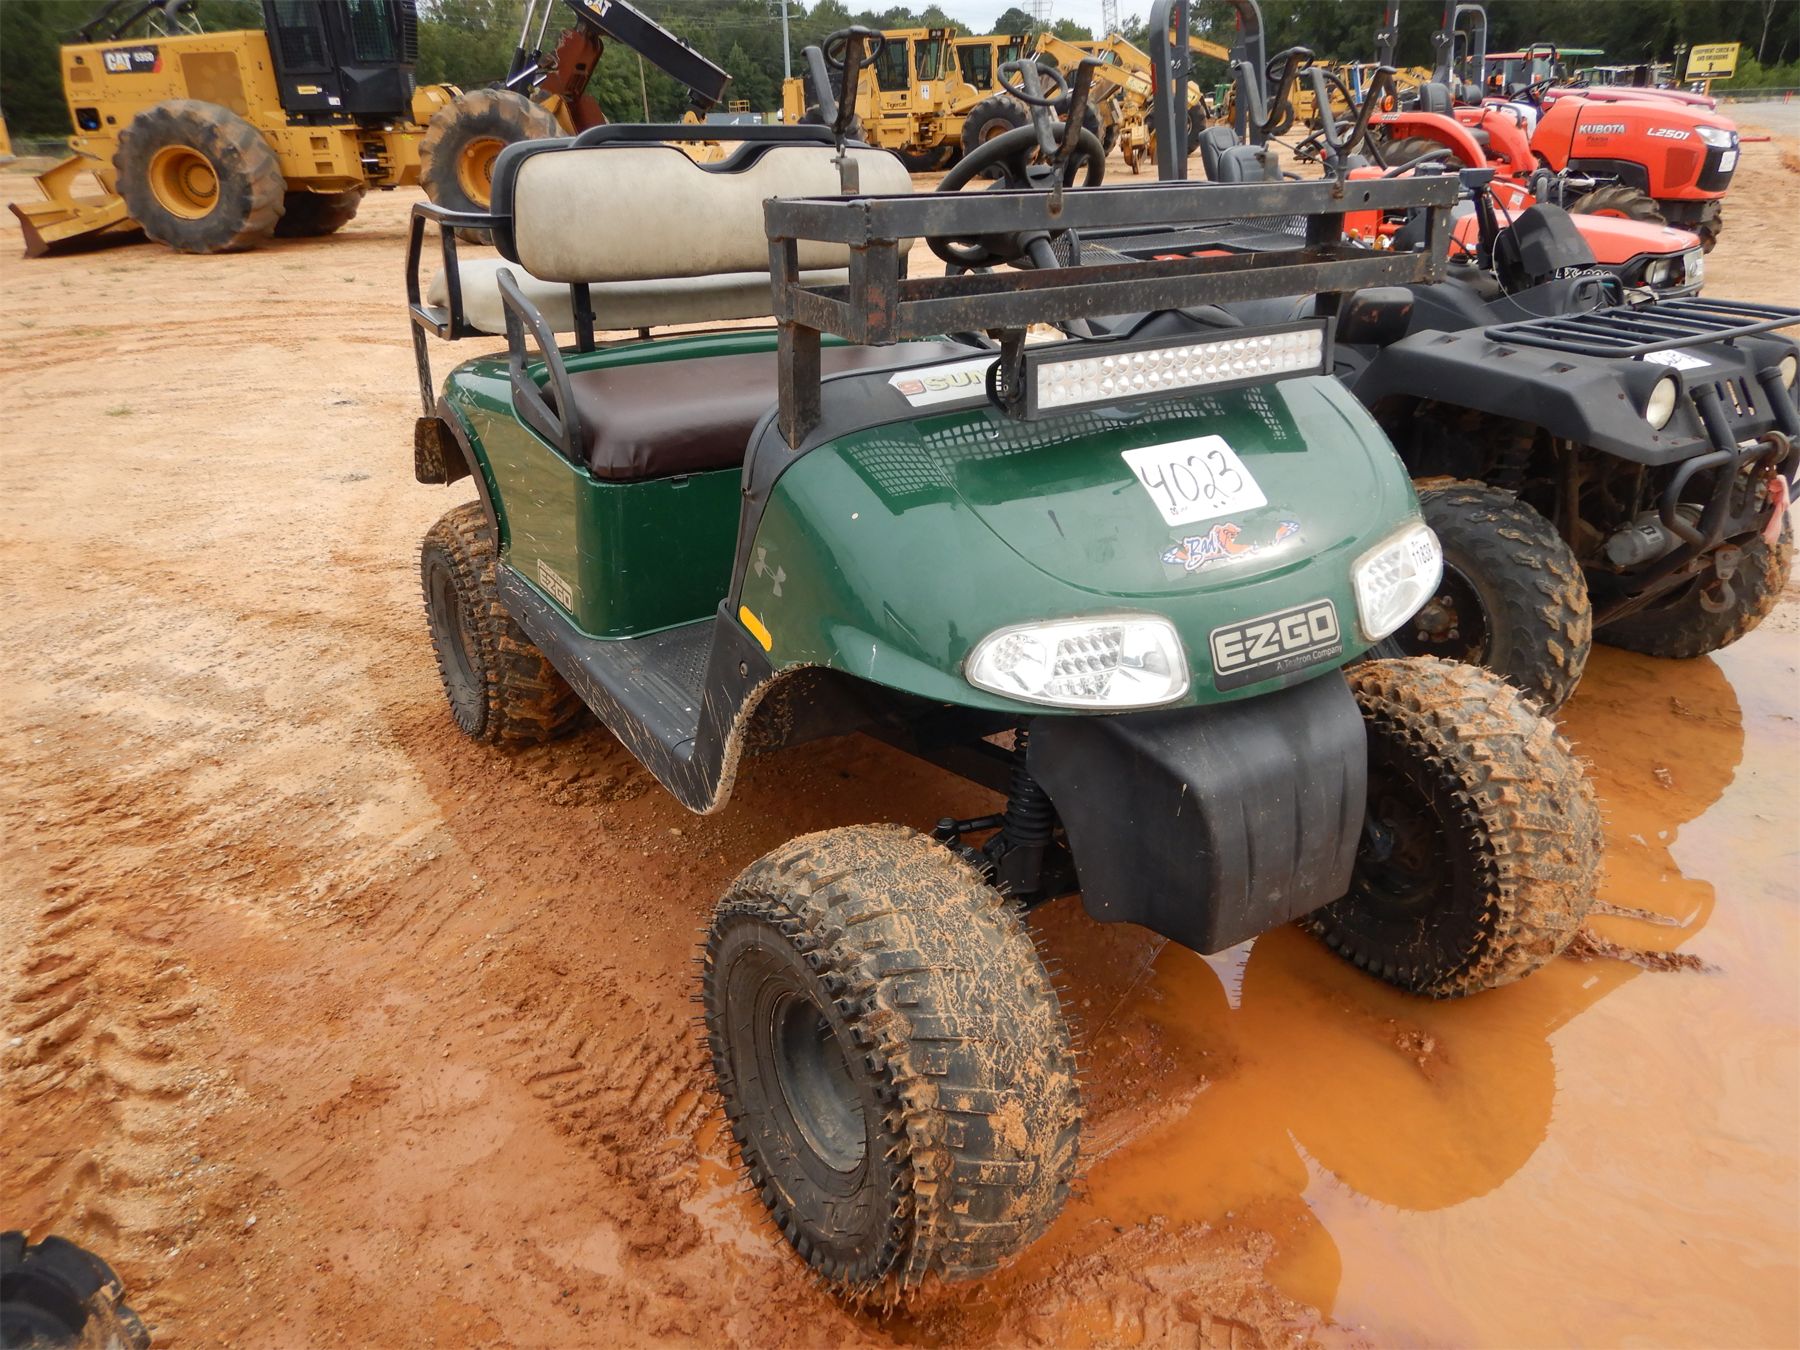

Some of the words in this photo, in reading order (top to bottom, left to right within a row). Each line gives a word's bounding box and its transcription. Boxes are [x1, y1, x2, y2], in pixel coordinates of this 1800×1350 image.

[104, 52, 132, 72] CAT
[886, 101, 908, 109] Tigercat
[1578, 124, 1626, 135] KUBOTA
[1647, 127, 1690, 141] L2501
[1140, 450, 1243, 507] 4023
[1312, 645, 1343, 660] Company
